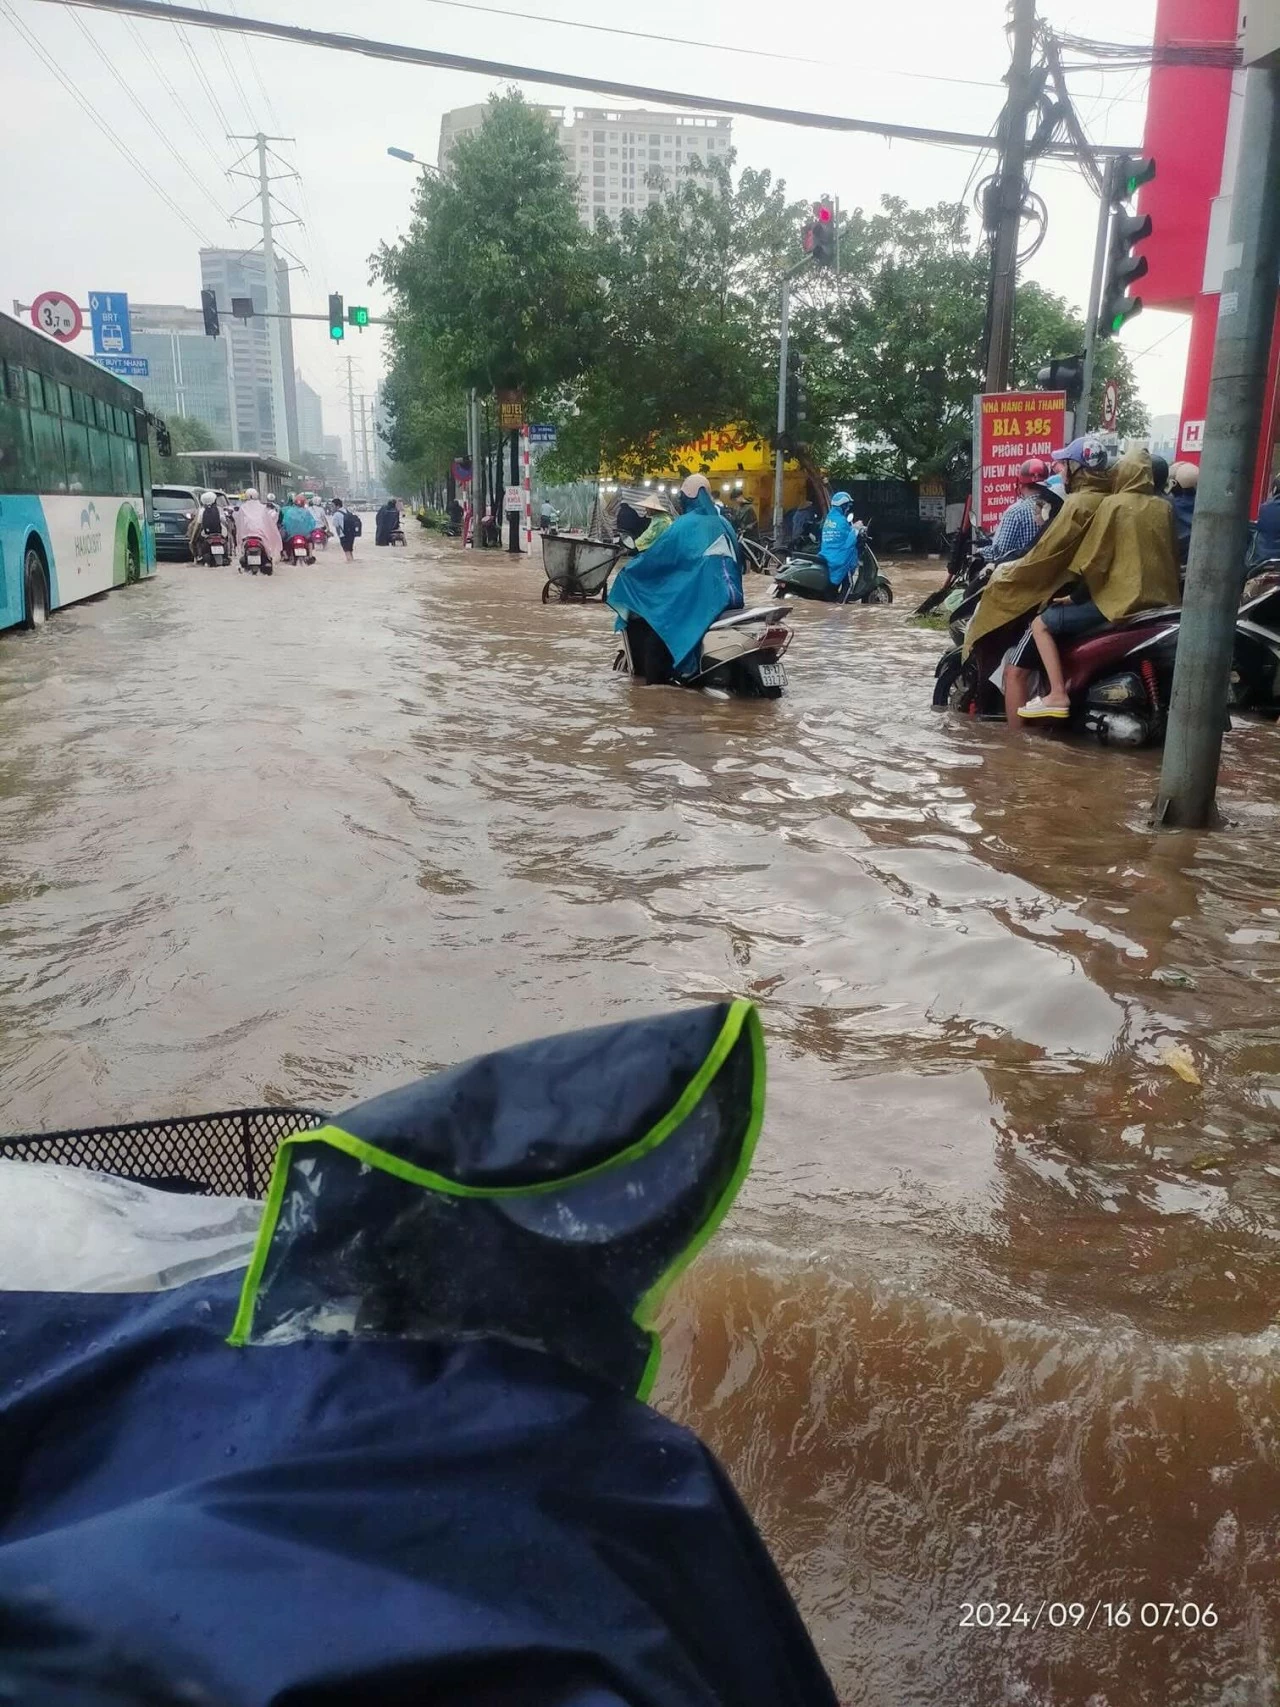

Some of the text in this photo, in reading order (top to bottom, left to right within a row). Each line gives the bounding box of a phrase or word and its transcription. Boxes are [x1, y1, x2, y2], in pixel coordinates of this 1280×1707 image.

[43, 308, 71, 328] 3,7 m
[102, 313, 118, 322] BRT
[502, 403, 522, 414] HOTEL
[983, 398, 1065, 413] NHÀ HÀNG HÀ THANH
[992, 418, 1051, 436] BIA 385
[992, 442, 1052, 458] PHÒNG LẠNH
[983, 465, 1007, 478] VIEW
[984, 483, 994, 493] CÓ
[996, 483, 1011, 492] CƠM
[988, 495, 1014, 505] KHÔNG
